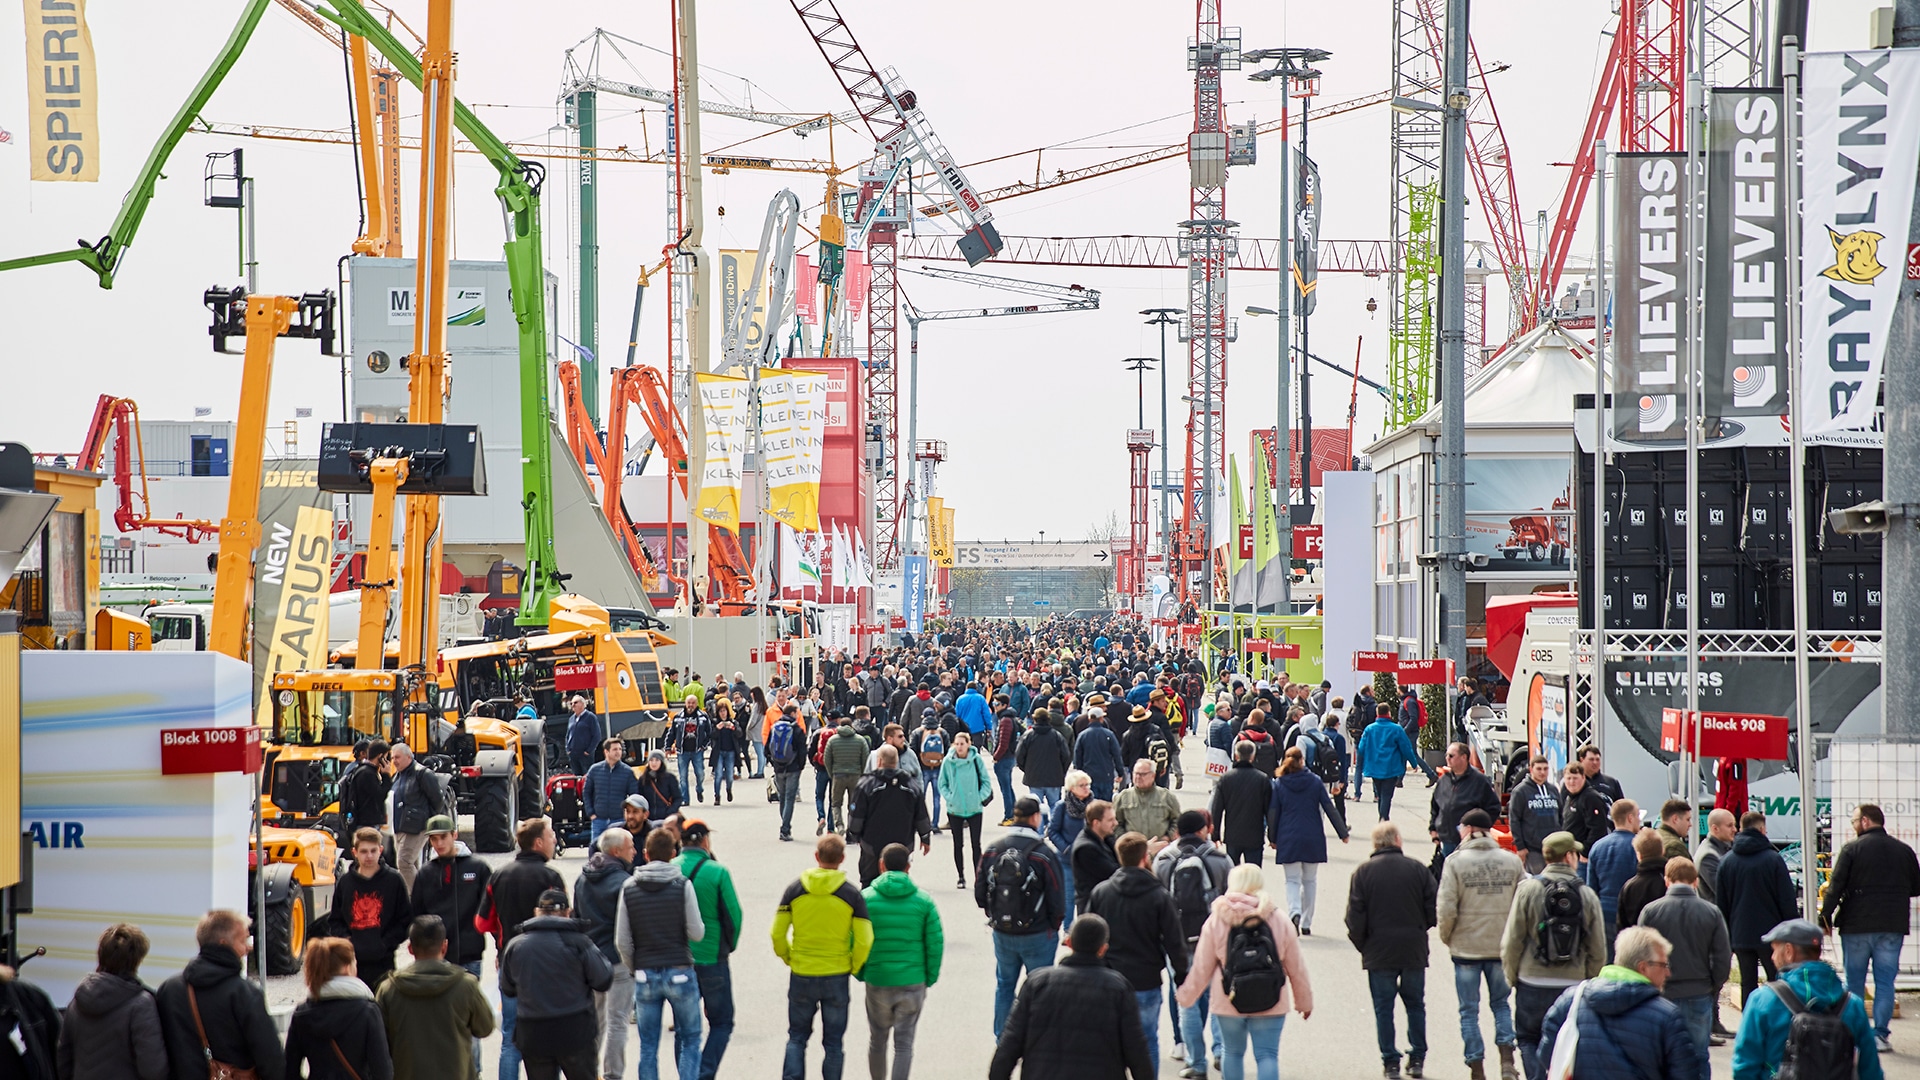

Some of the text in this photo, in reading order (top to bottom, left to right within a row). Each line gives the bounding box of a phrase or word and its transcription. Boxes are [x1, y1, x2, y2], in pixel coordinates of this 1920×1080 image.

[1834, 52, 1891, 226] LYNX
[1306, 174, 1315, 220] JEKKO
[1732, 95, 1778, 355] LIEVERS
[726, 264, 735, 296] eDrive
[1638, 158, 1678, 386] LIEVERS
[261, 521, 293, 586] NEW
[957, 547, 980, 564] FS
[149, 575, 181, 583] Betonpumpe
[909, 562, 921, 633] SERMAC
[1531, 649, 1553, 662] E025
[555, 666, 575, 676] Block
[576, 665, 594, 674] 1007
[1398, 661, 1433, 670] Block 907
[311, 682, 344, 690] DIECI
[1634, 671, 1724, 687] LIEVERS
[281, 692, 293, 704] 40
[1703, 716, 1767, 732] Block 908
[163, 730, 200, 746] Block
[203, 729, 238, 744] 1008
[1209, 762, 1229, 774] PERI
[1528, 799, 1542, 809] PRO
[29, 821, 85, 848] AIR
